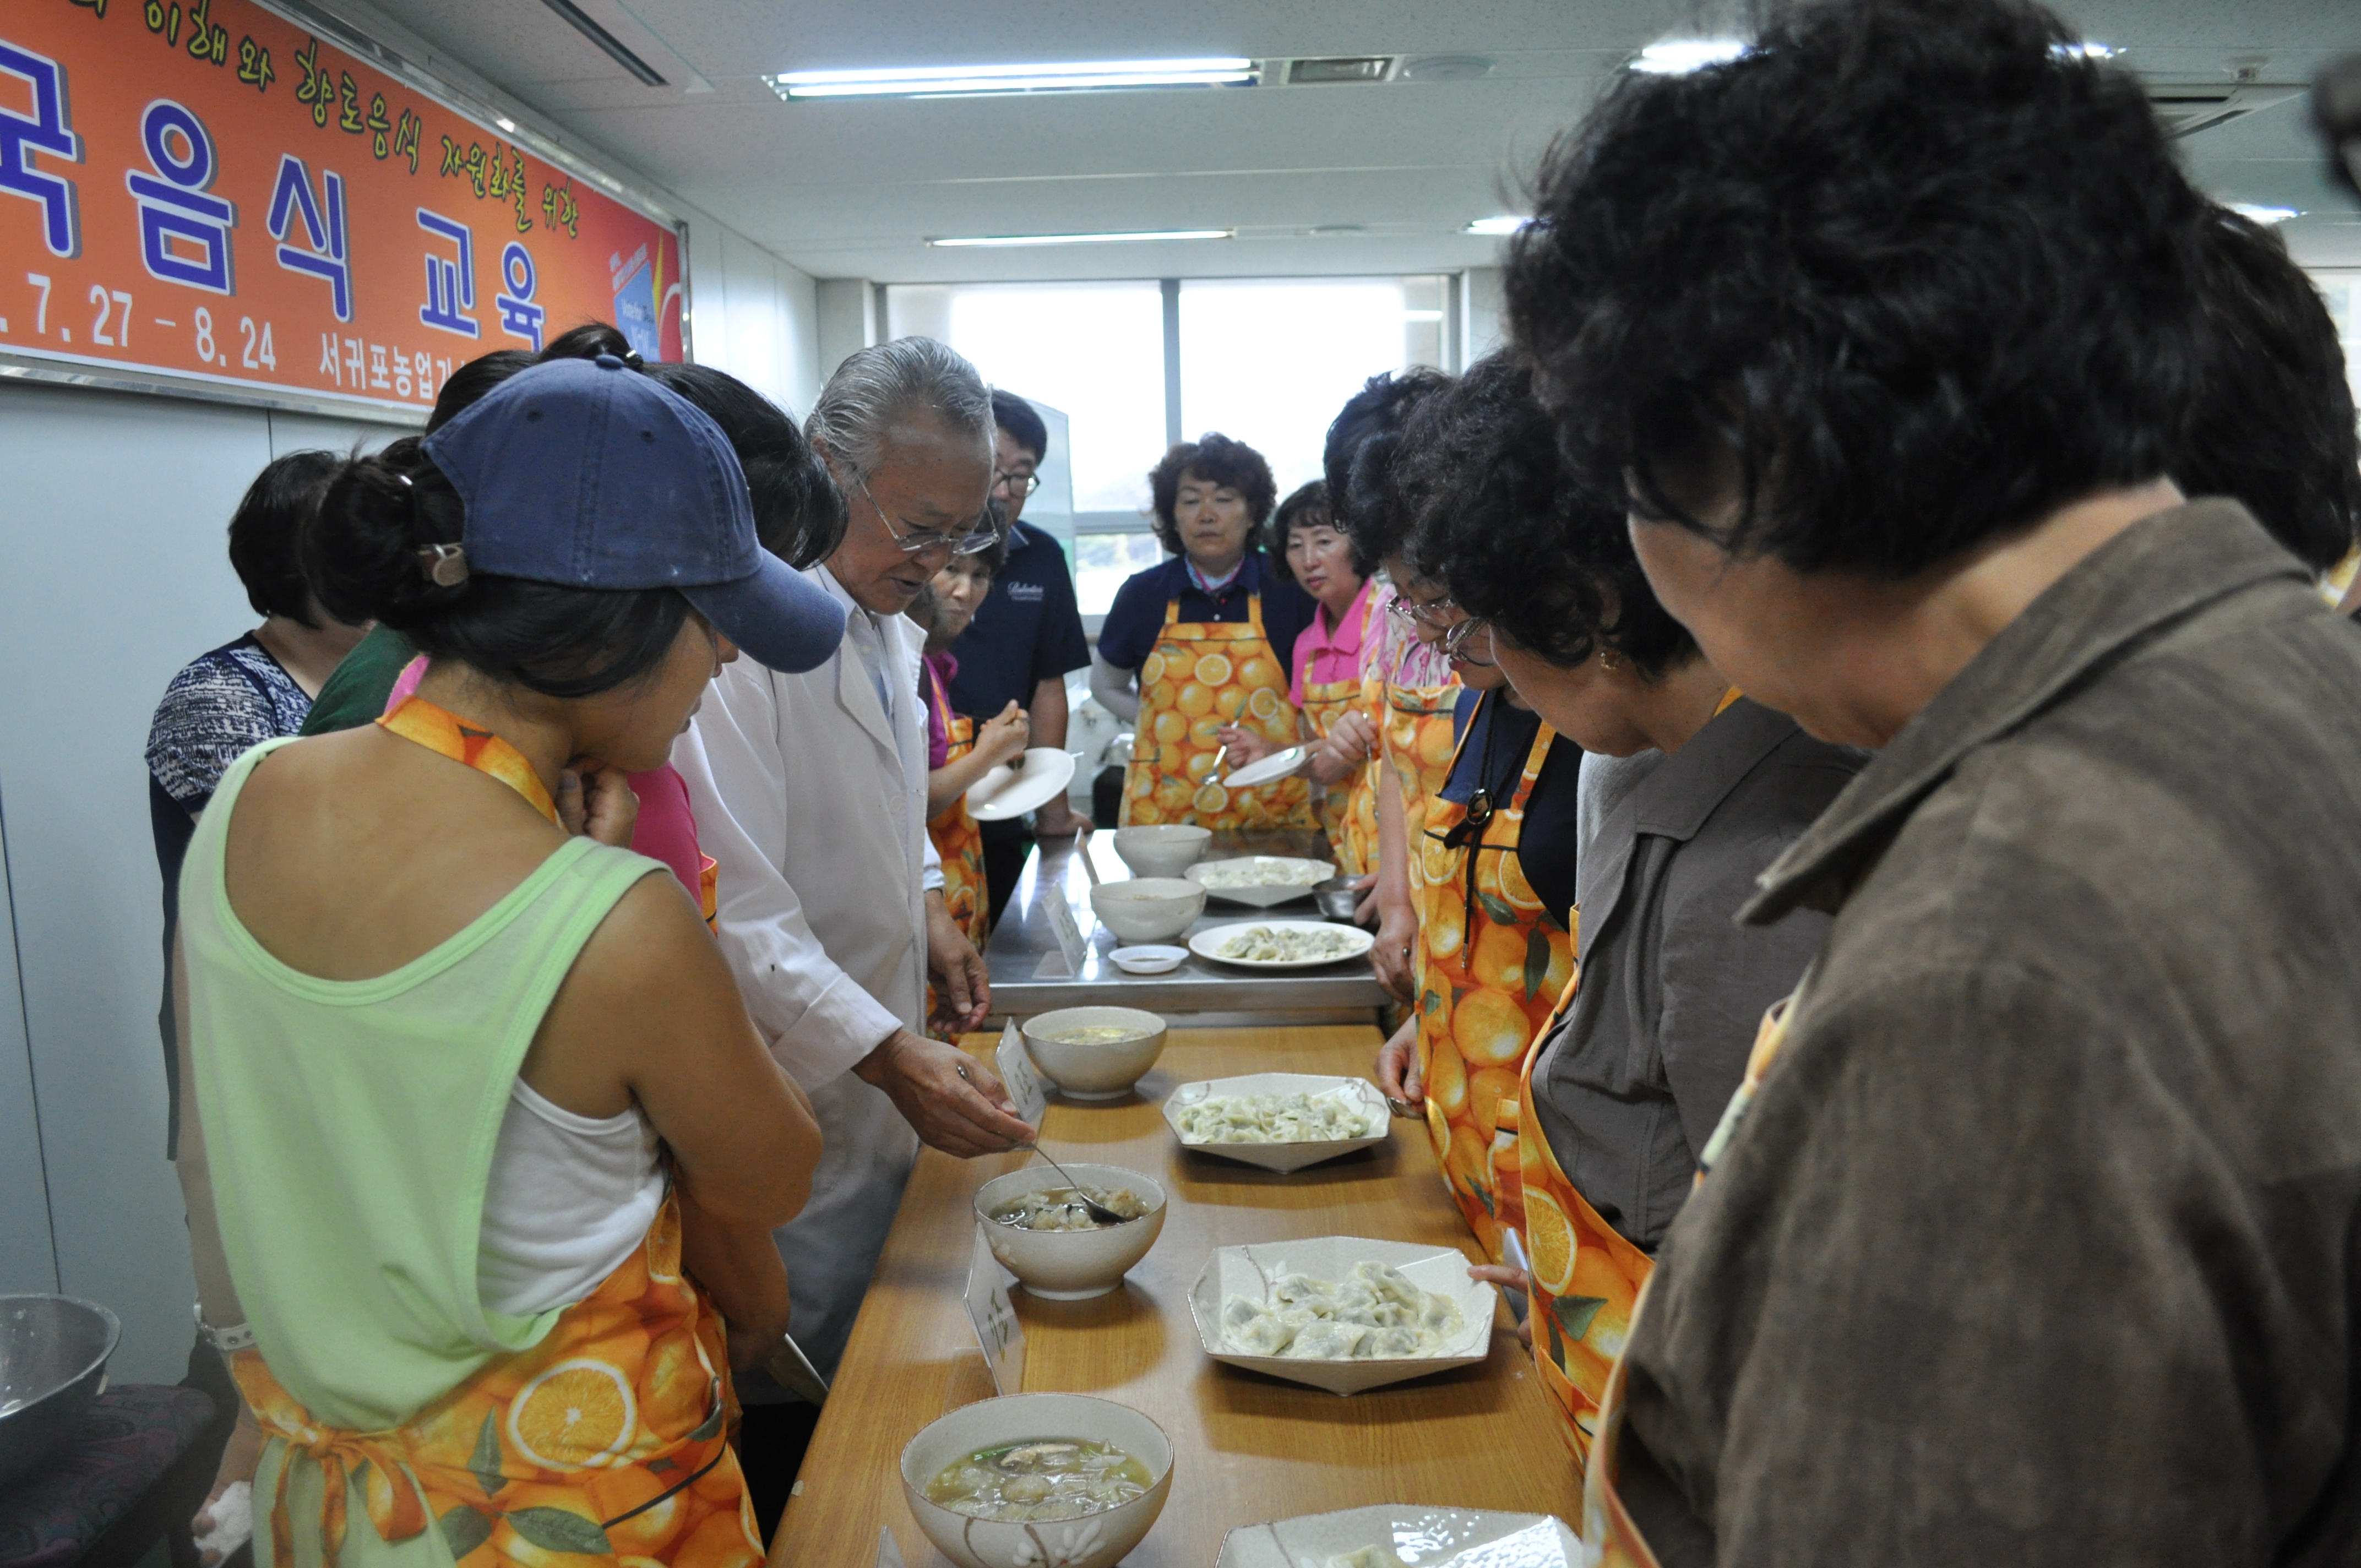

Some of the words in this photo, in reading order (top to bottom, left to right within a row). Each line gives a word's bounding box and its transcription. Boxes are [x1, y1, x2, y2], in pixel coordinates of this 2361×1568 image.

[295, 36, 422, 175] 향토음식
[440, 141, 532, 232] 자원화를
[542, 176, 579, 238] 위한
[416, 206, 546, 353] 교육
[319, 332, 466, 400] 서귀포농업기
